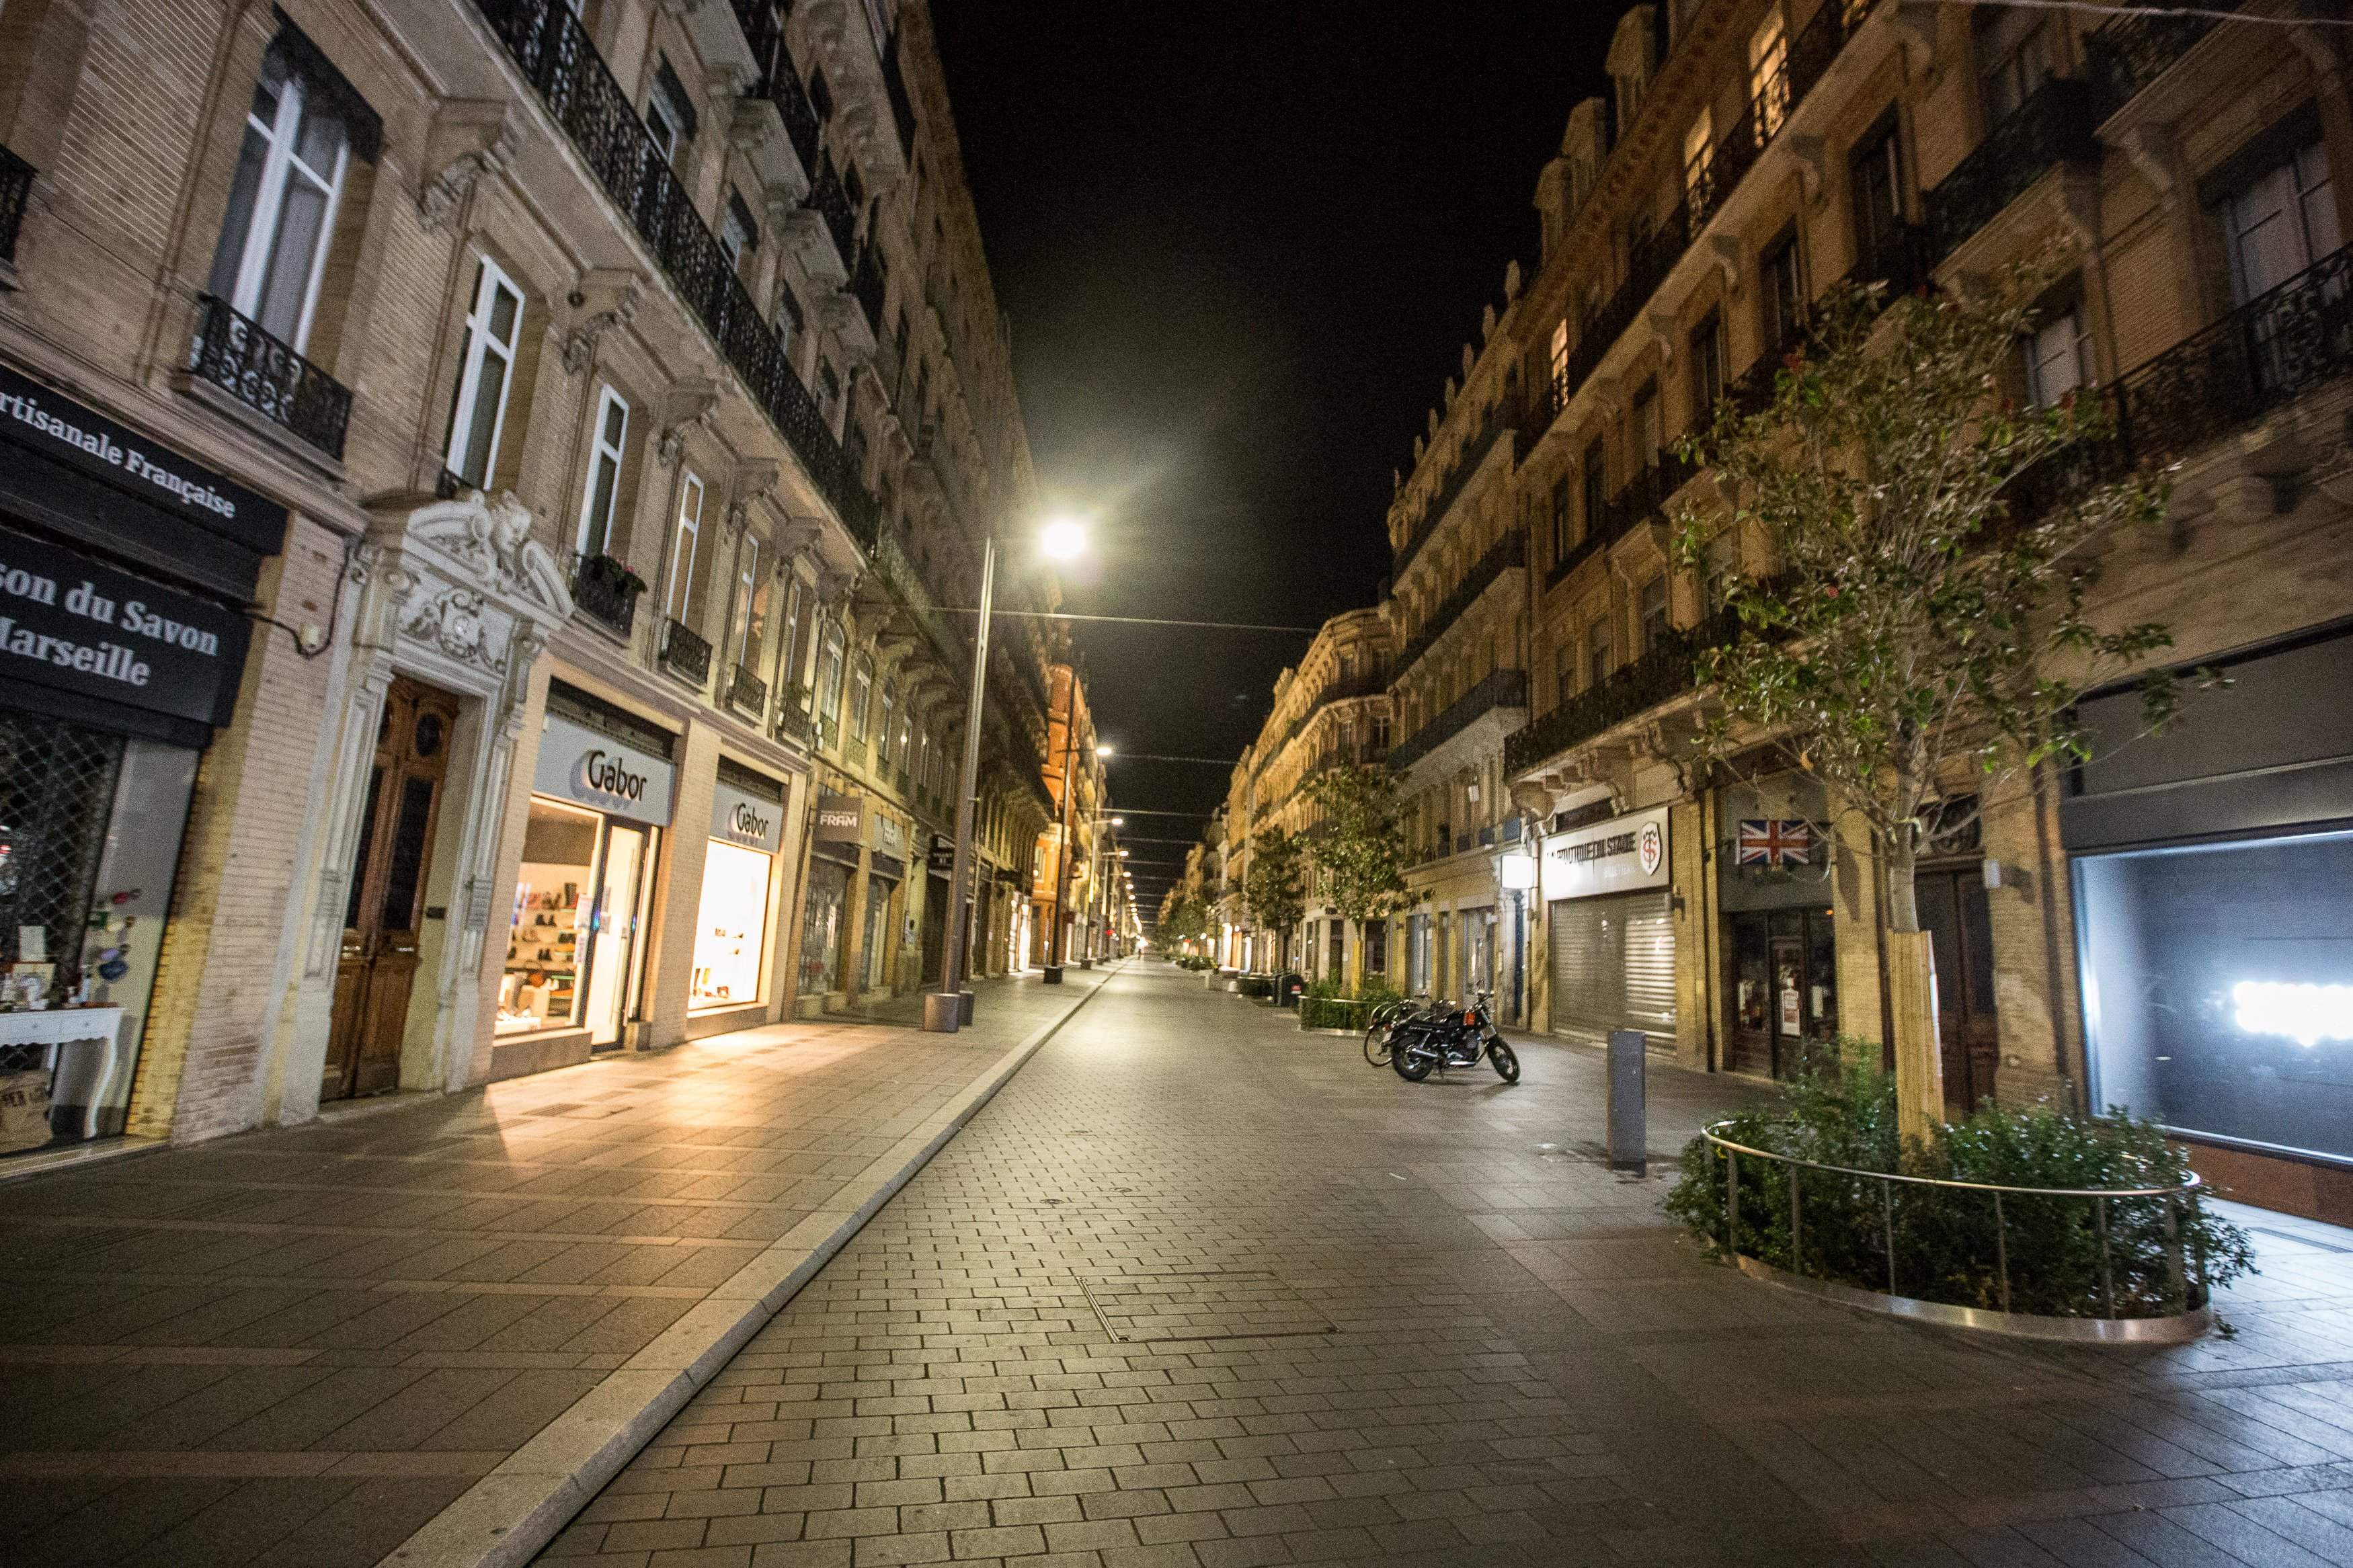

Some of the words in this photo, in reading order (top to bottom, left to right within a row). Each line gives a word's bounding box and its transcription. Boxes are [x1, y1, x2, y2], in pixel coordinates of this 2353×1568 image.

[124, 448, 236, 519] Française
[65, 580, 116, 624] du
[120, 600, 219, 657] Savon
[588, 749, 647, 801] Gabor
[736, 802, 769, 837] Gabor
[820, 814, 858, 827] FRAM
